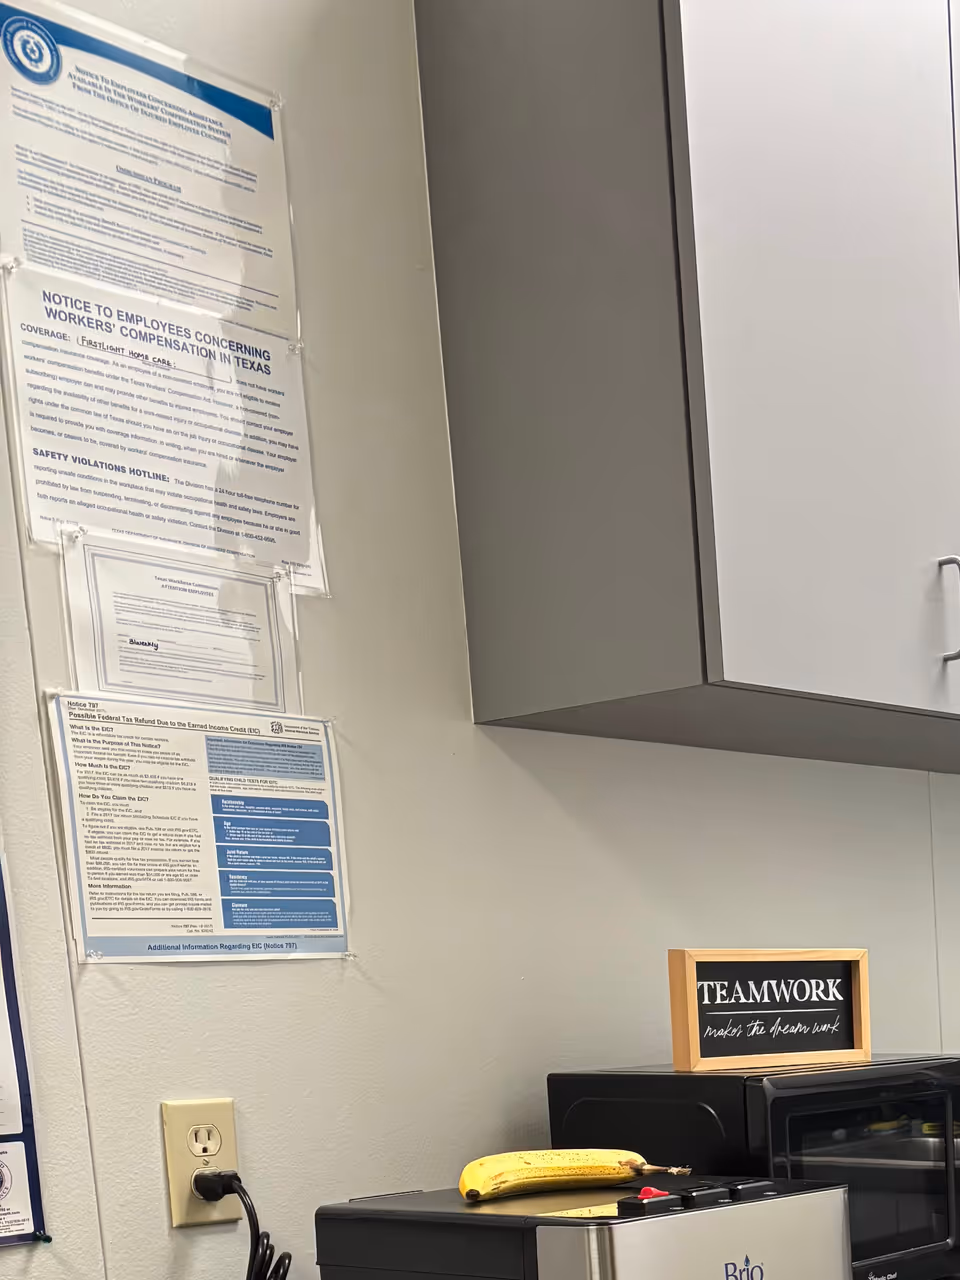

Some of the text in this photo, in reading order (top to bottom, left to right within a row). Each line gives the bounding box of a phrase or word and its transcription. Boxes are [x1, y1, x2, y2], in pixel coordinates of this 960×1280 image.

[20, 322, 70, 342] COVERAGE:
[42, 289, 270, 361] NOTICE TO EMPLOYEES CONCERNING
[45, 306, 271, 375] WORKERS' COMPENSATION IN TEXAS
[32, 447, 68, 462] SAFETY
[71, 455, 126, 473] VIOLATIONS
[129, 467, 169, 482] HOTLINE:
[68, 711, 95, 719] Possible
[98, 714, 120, 722] Federal
[697, 979, 843, 1004] TEAMWORK
[704, 1015, 840, 1038] makes the dream work
